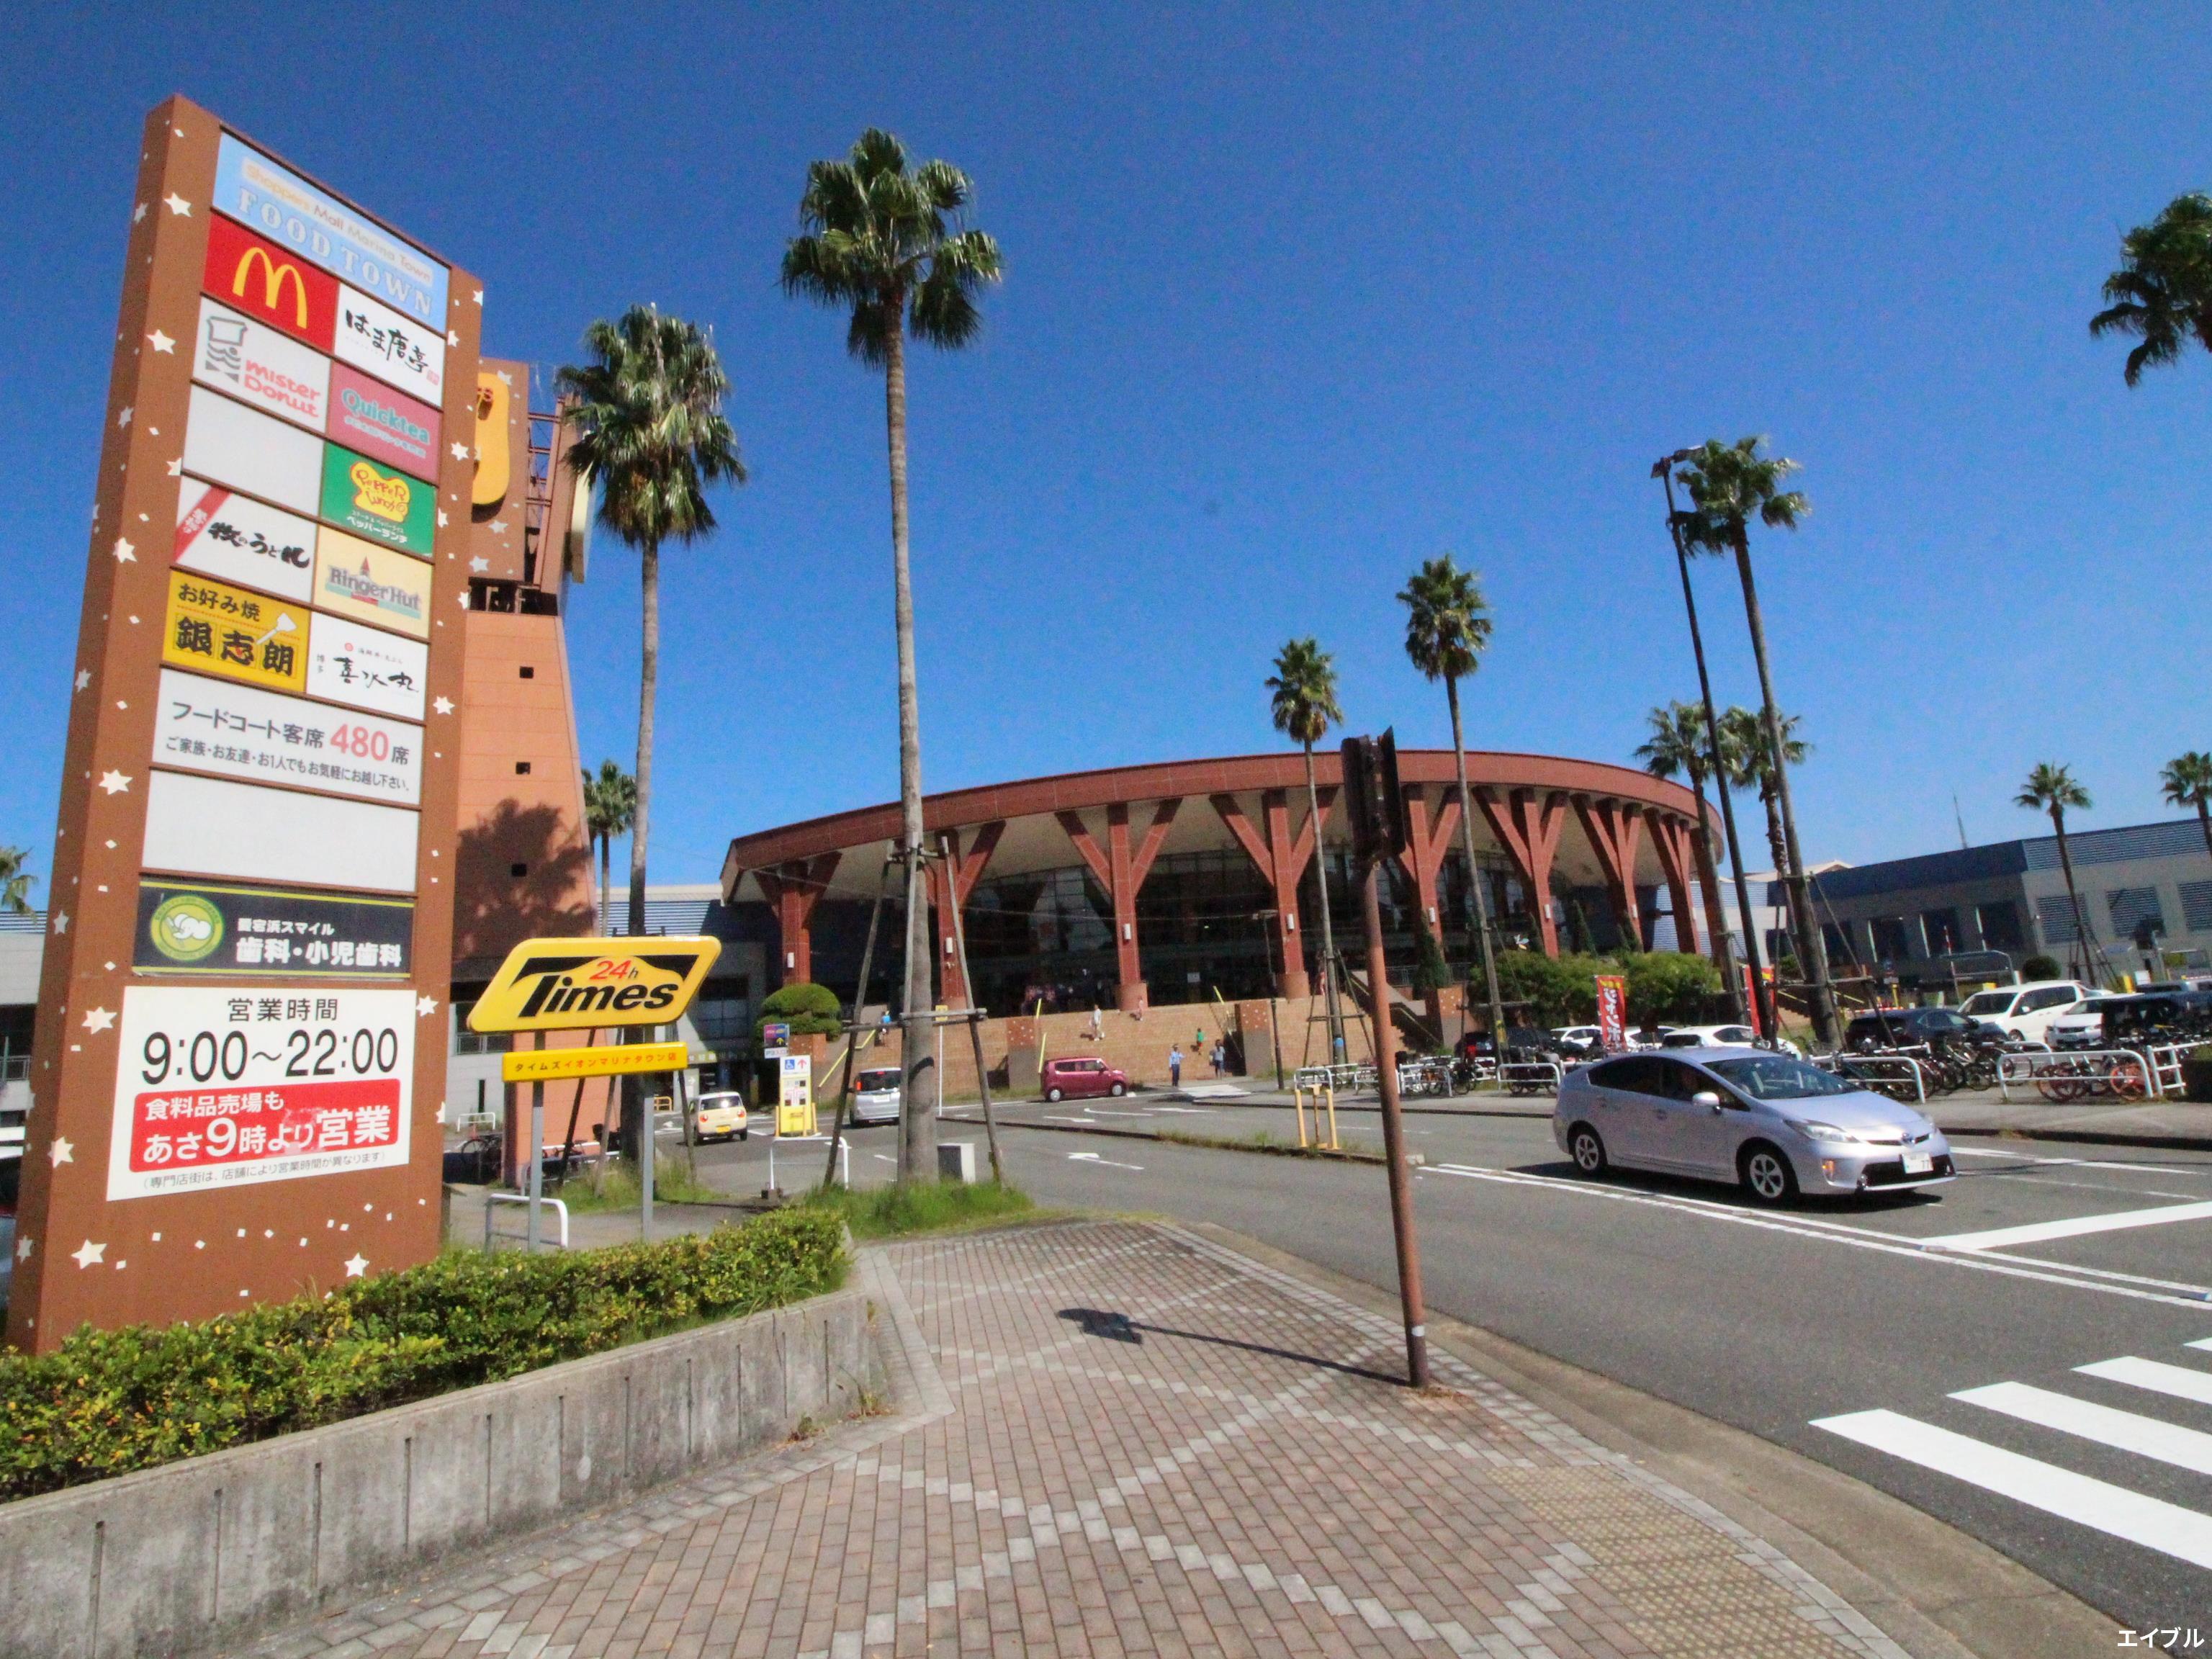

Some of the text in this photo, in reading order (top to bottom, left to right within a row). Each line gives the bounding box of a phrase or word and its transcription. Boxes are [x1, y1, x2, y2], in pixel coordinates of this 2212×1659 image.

[238, 187, 432, 317] FOOD TOWN
[314, 204, 343, 230] Mall
[348, 225, 395, 261] Marina
[399, 253, 431, 282] Town
[179, 583, 260, 622] お好み焼
[328, 566, 421, 611] Ringer Hut
[236, 937, 402, 967] 歯科・小児歯科
[228, 997, 338, 1022] 営業時間
[518, 974, 679, 1018] Times
[145, 1091, 284, 1122] 食料品売場も
[143, 1105, 391, 1164] あさ9時より営業
